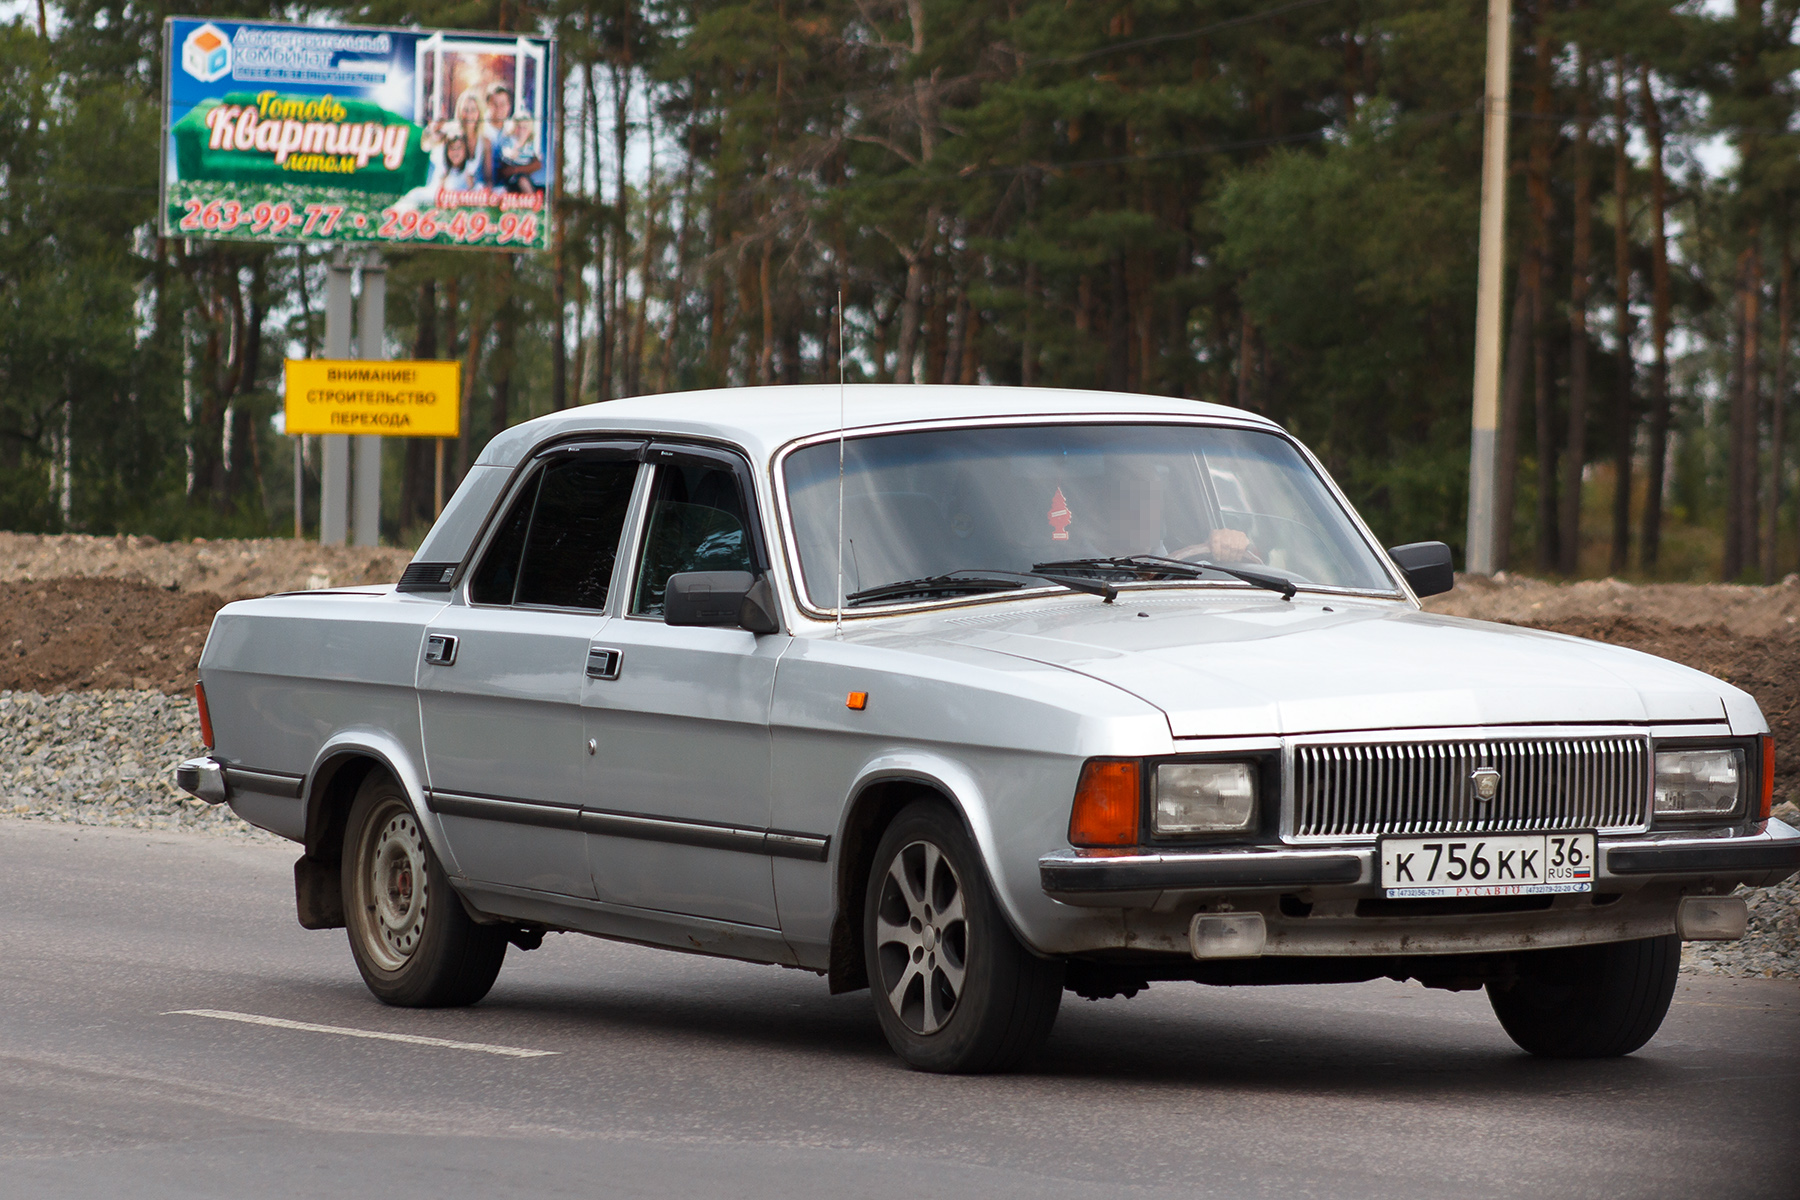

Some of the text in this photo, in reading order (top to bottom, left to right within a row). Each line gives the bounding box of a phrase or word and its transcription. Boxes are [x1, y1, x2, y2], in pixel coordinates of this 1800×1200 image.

[233, 27, 391, 52] Домостроительный
[257, 90, 347, 122] Готовь
[205, 104, 410, 171] Квартиру
[282, 153, 356, 174] летом
[180, 199, 537, 244] 263-99-77 296-49-94
[327, 369, 416, 383] ВНИМАНИЕ!
[306, 389, 437, 405] СТРОИТЕЛЬСТВО
[330, 412, 411, 427] ПЕРЕХОДА
[1551, 838, 1583, 866] 36
[1548, 867, 1573, 878] RUS
